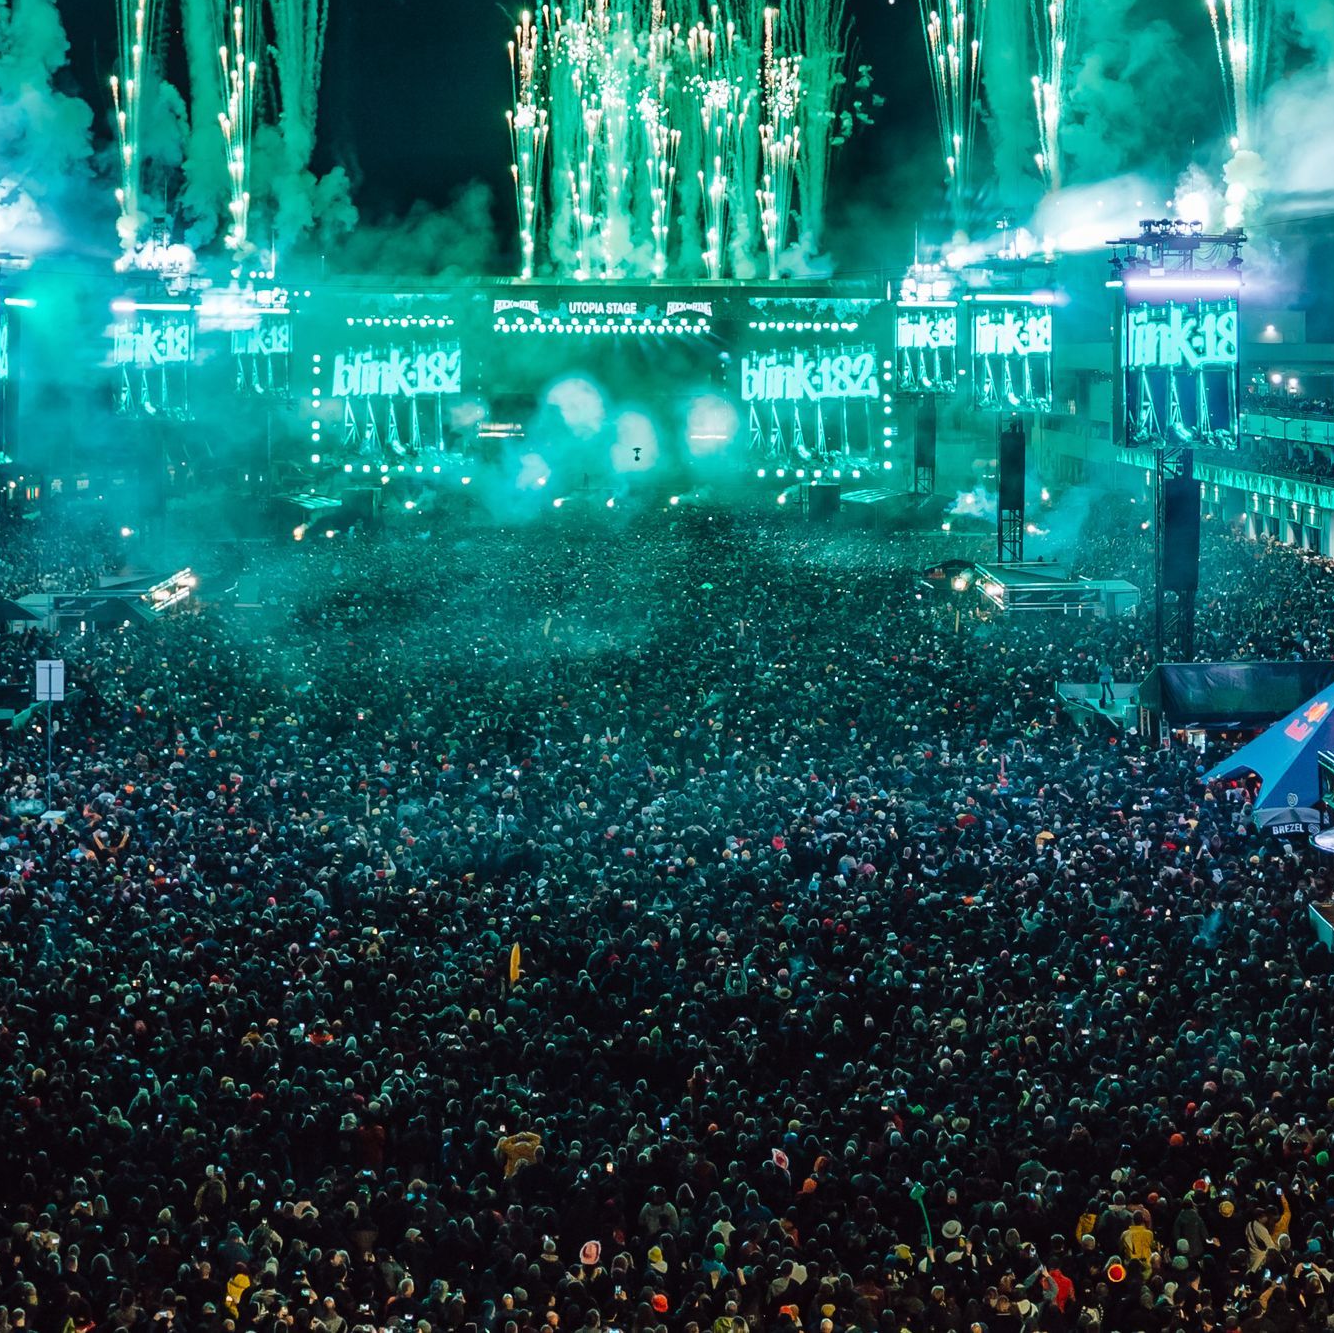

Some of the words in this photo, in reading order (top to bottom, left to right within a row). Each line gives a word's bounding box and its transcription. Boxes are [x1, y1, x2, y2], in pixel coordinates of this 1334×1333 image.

[569, 302, 605, 314] UTOPIA
[606, 302, 637, 315] STAGE
[741, 353, 880, 401] blink-182
[1272, 823, 1305, 835] BREZEL
